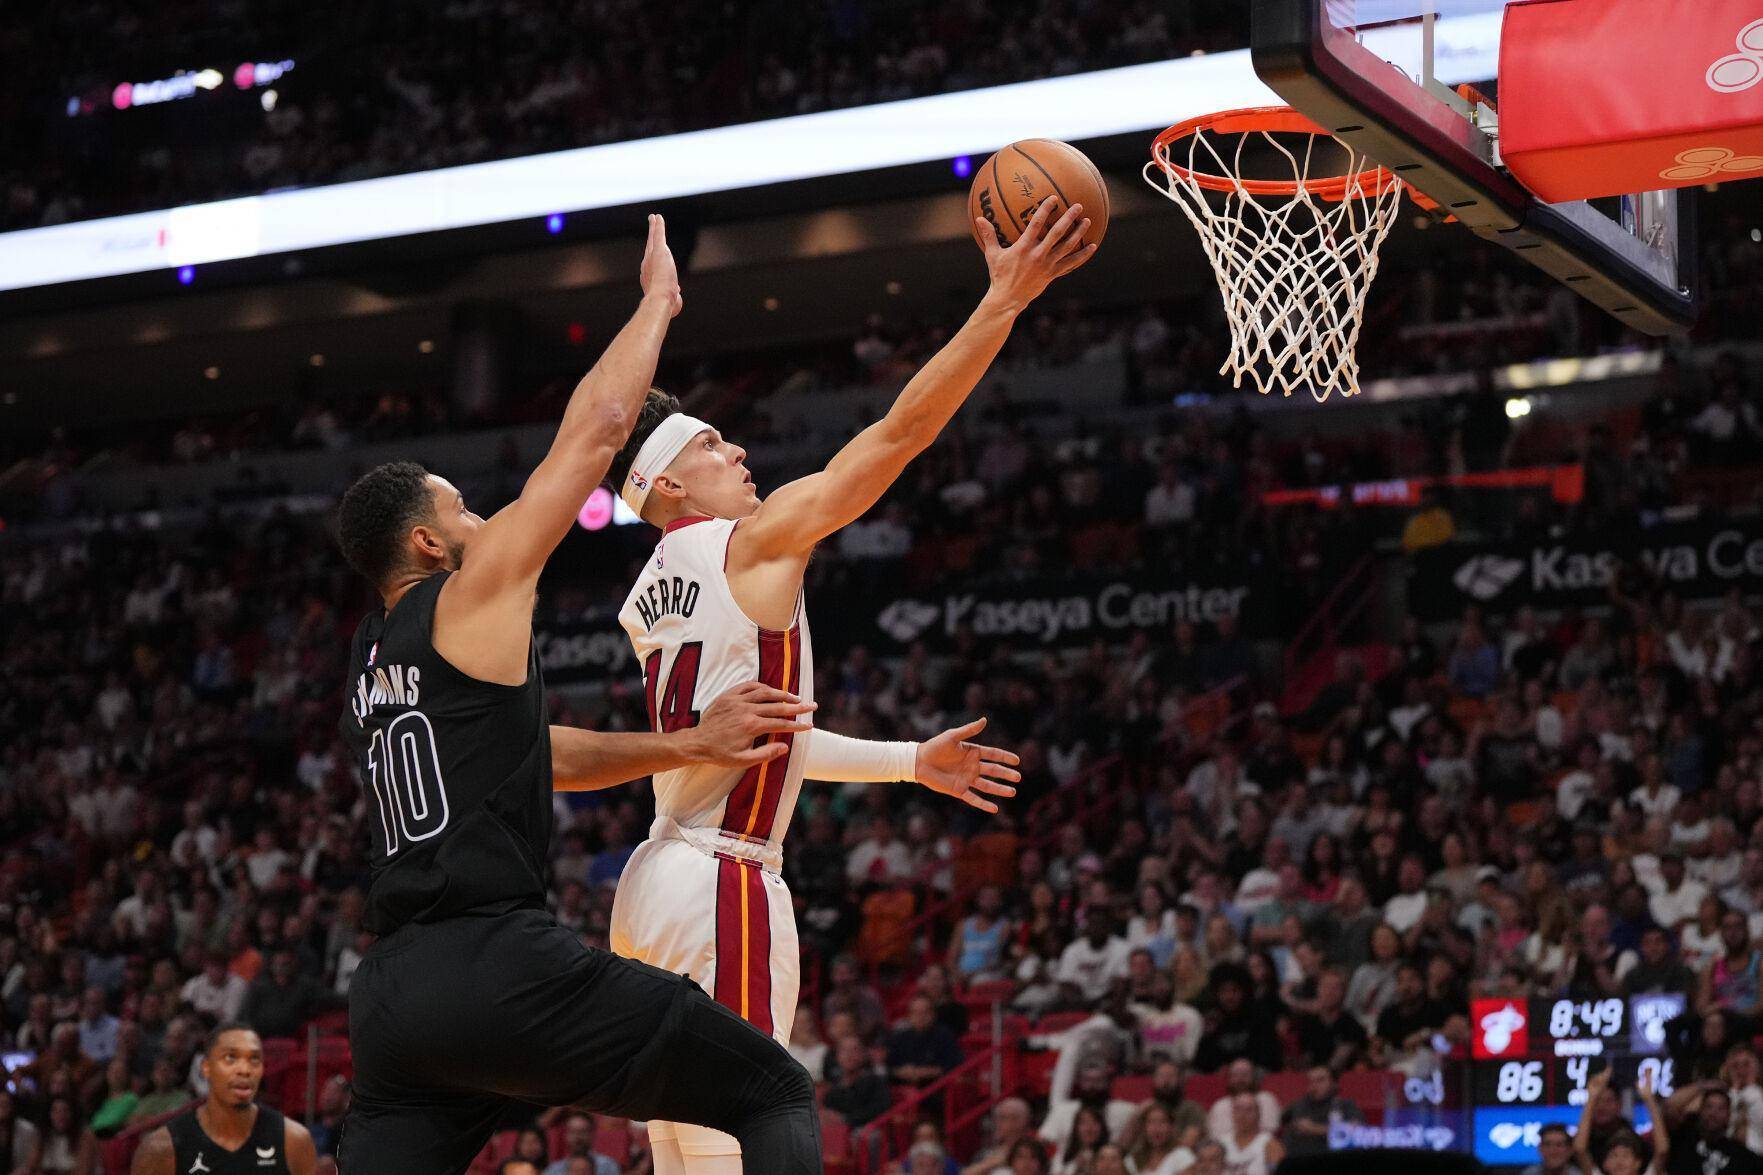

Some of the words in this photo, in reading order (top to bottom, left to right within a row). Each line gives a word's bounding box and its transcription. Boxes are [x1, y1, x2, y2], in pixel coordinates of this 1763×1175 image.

[635, 576, 700, 632] HERRO
[1098, 582, 1250, 628] Center
[351, 664, 421, 729] SMONS
[643, 640, 703, 734] 14
[367, 710, 450, 857] 10
[1549, 998, 1624, 1038] 8:49
[1497, 1060, 1543, 1103] 86
